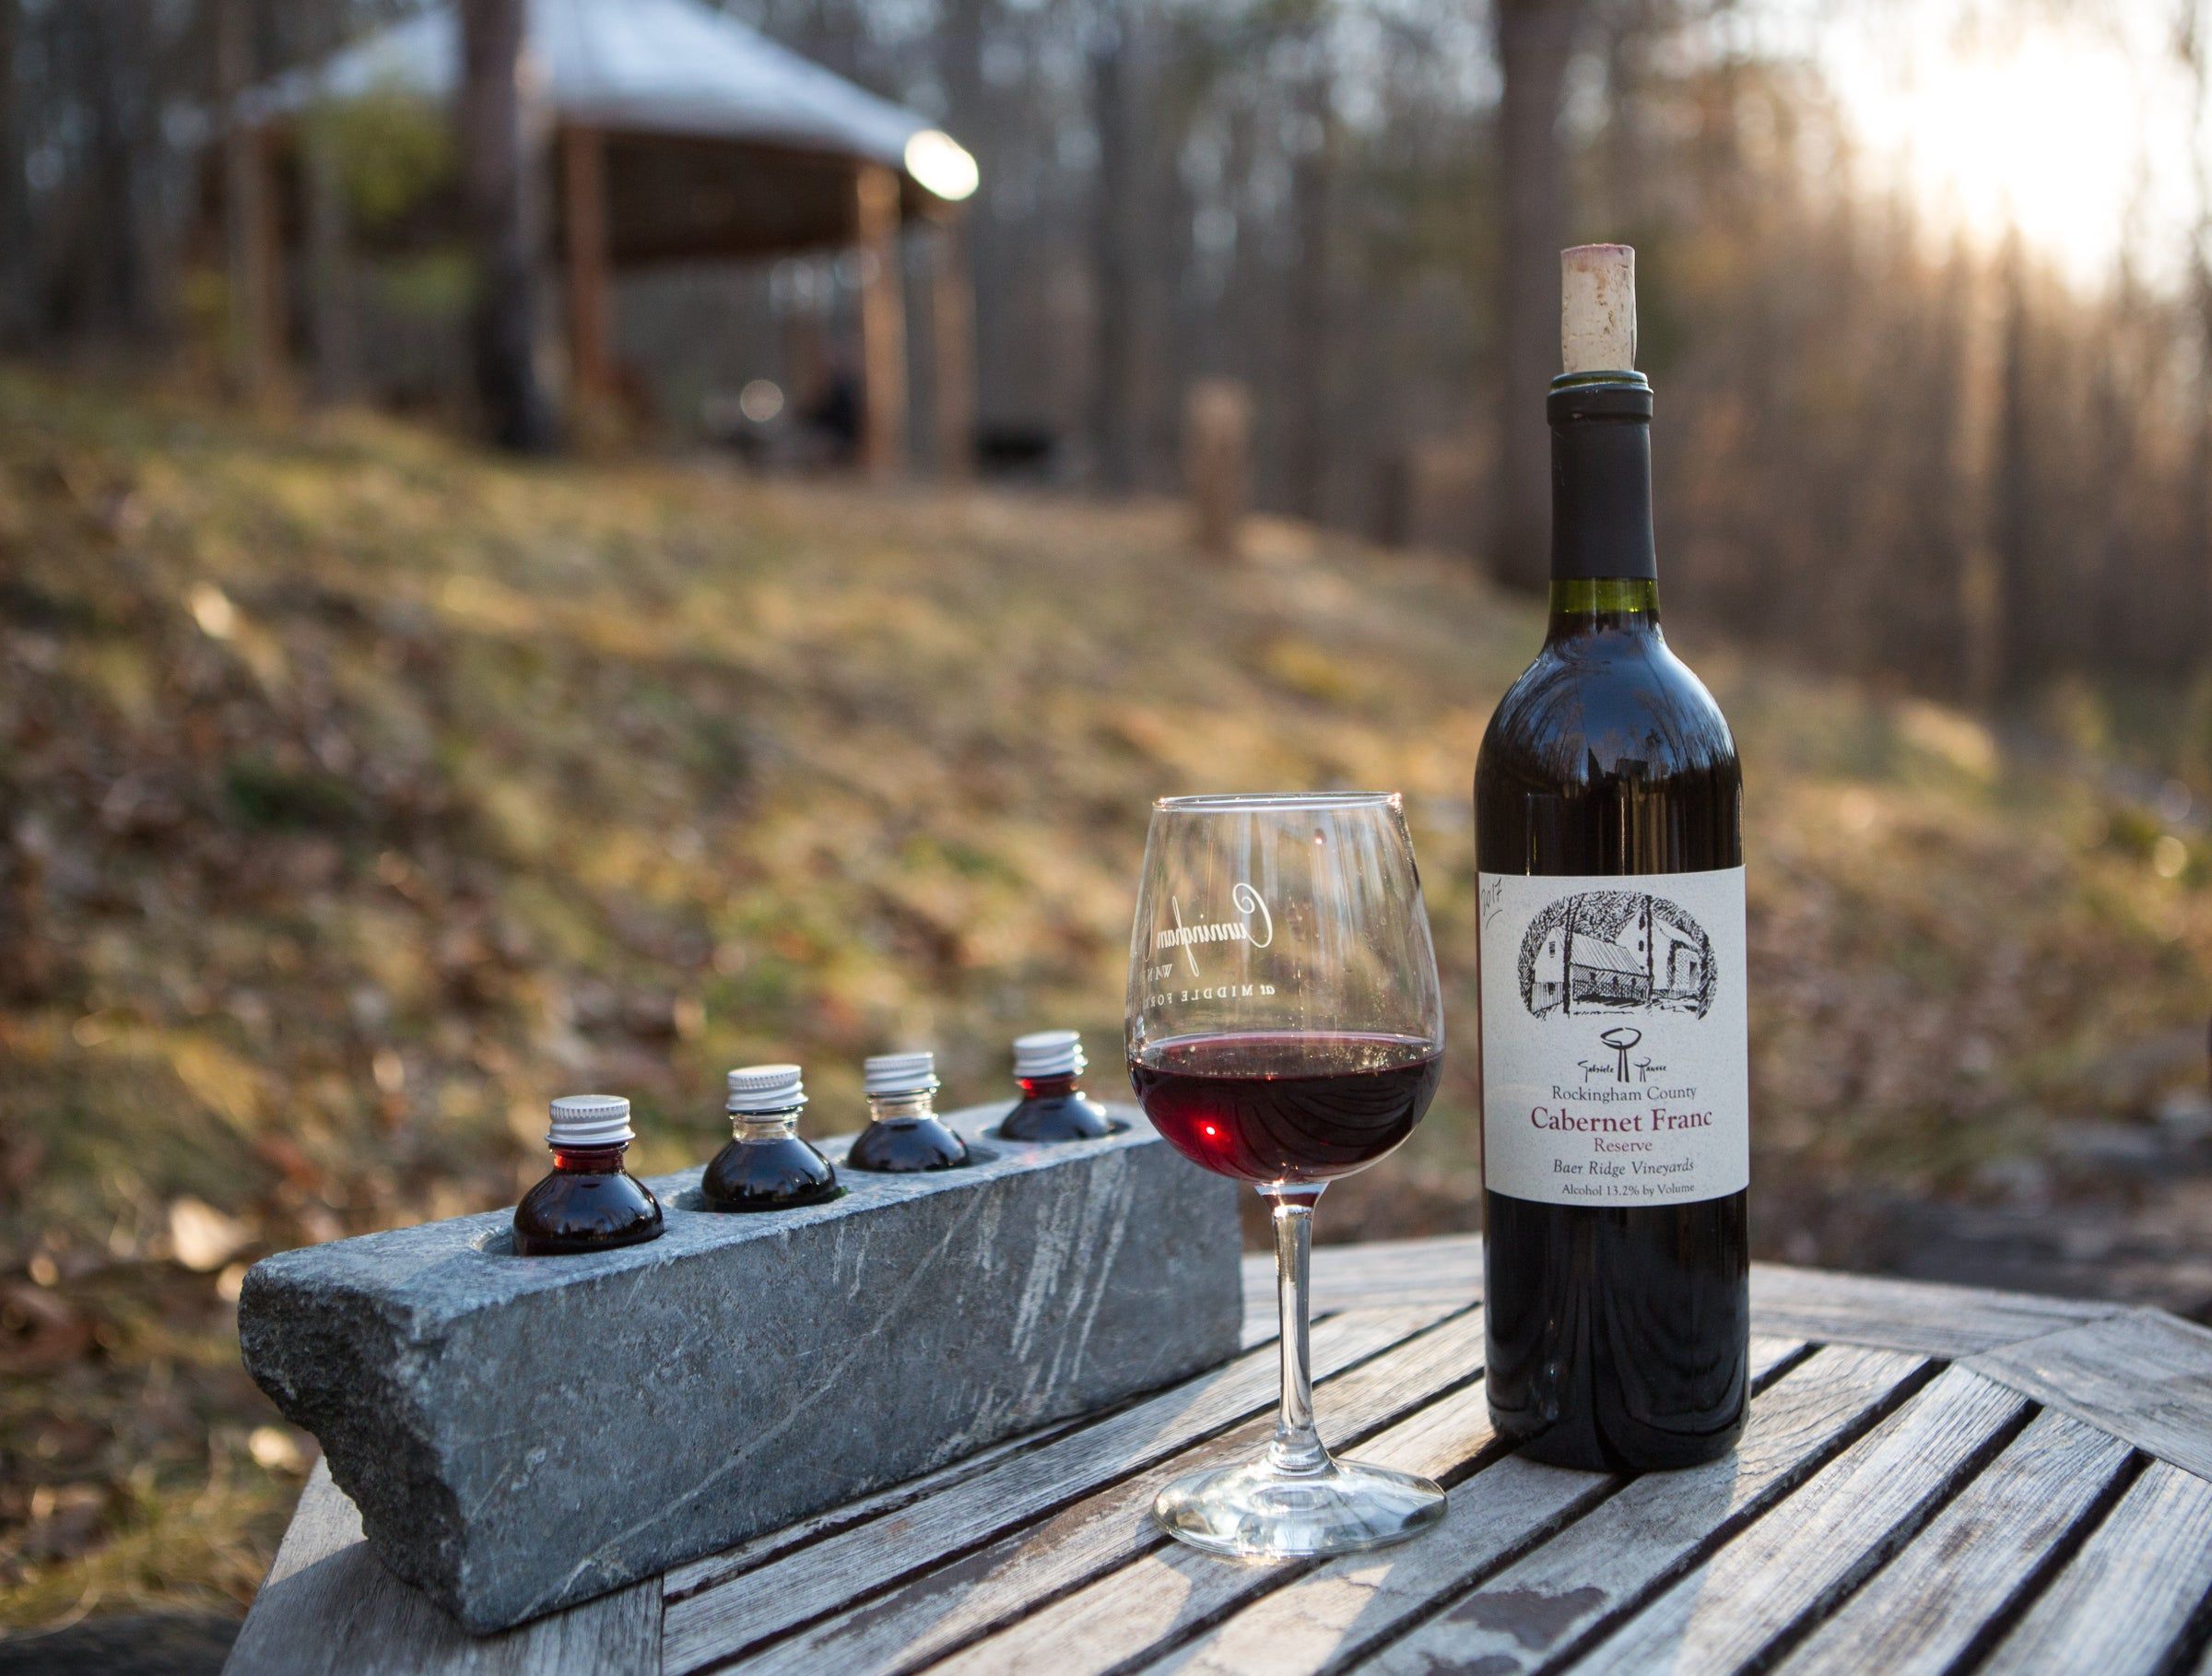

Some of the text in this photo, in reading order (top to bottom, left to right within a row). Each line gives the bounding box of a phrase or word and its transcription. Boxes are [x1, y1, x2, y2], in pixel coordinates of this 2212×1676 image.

[1480, 877, 1503, 916] 2017
[1551, 1085, 1698, 1104] Rockingham County
[1530, 1105, 1713, 1133] Cabernet Franc
[1593, 1137, 1653, 1153] Reserve
[1553, 1157, 1695, 1178] Baer Ridge Vineyards
[1561, 1183, 1696, 1198] Alcohol 13.2% by Volume
